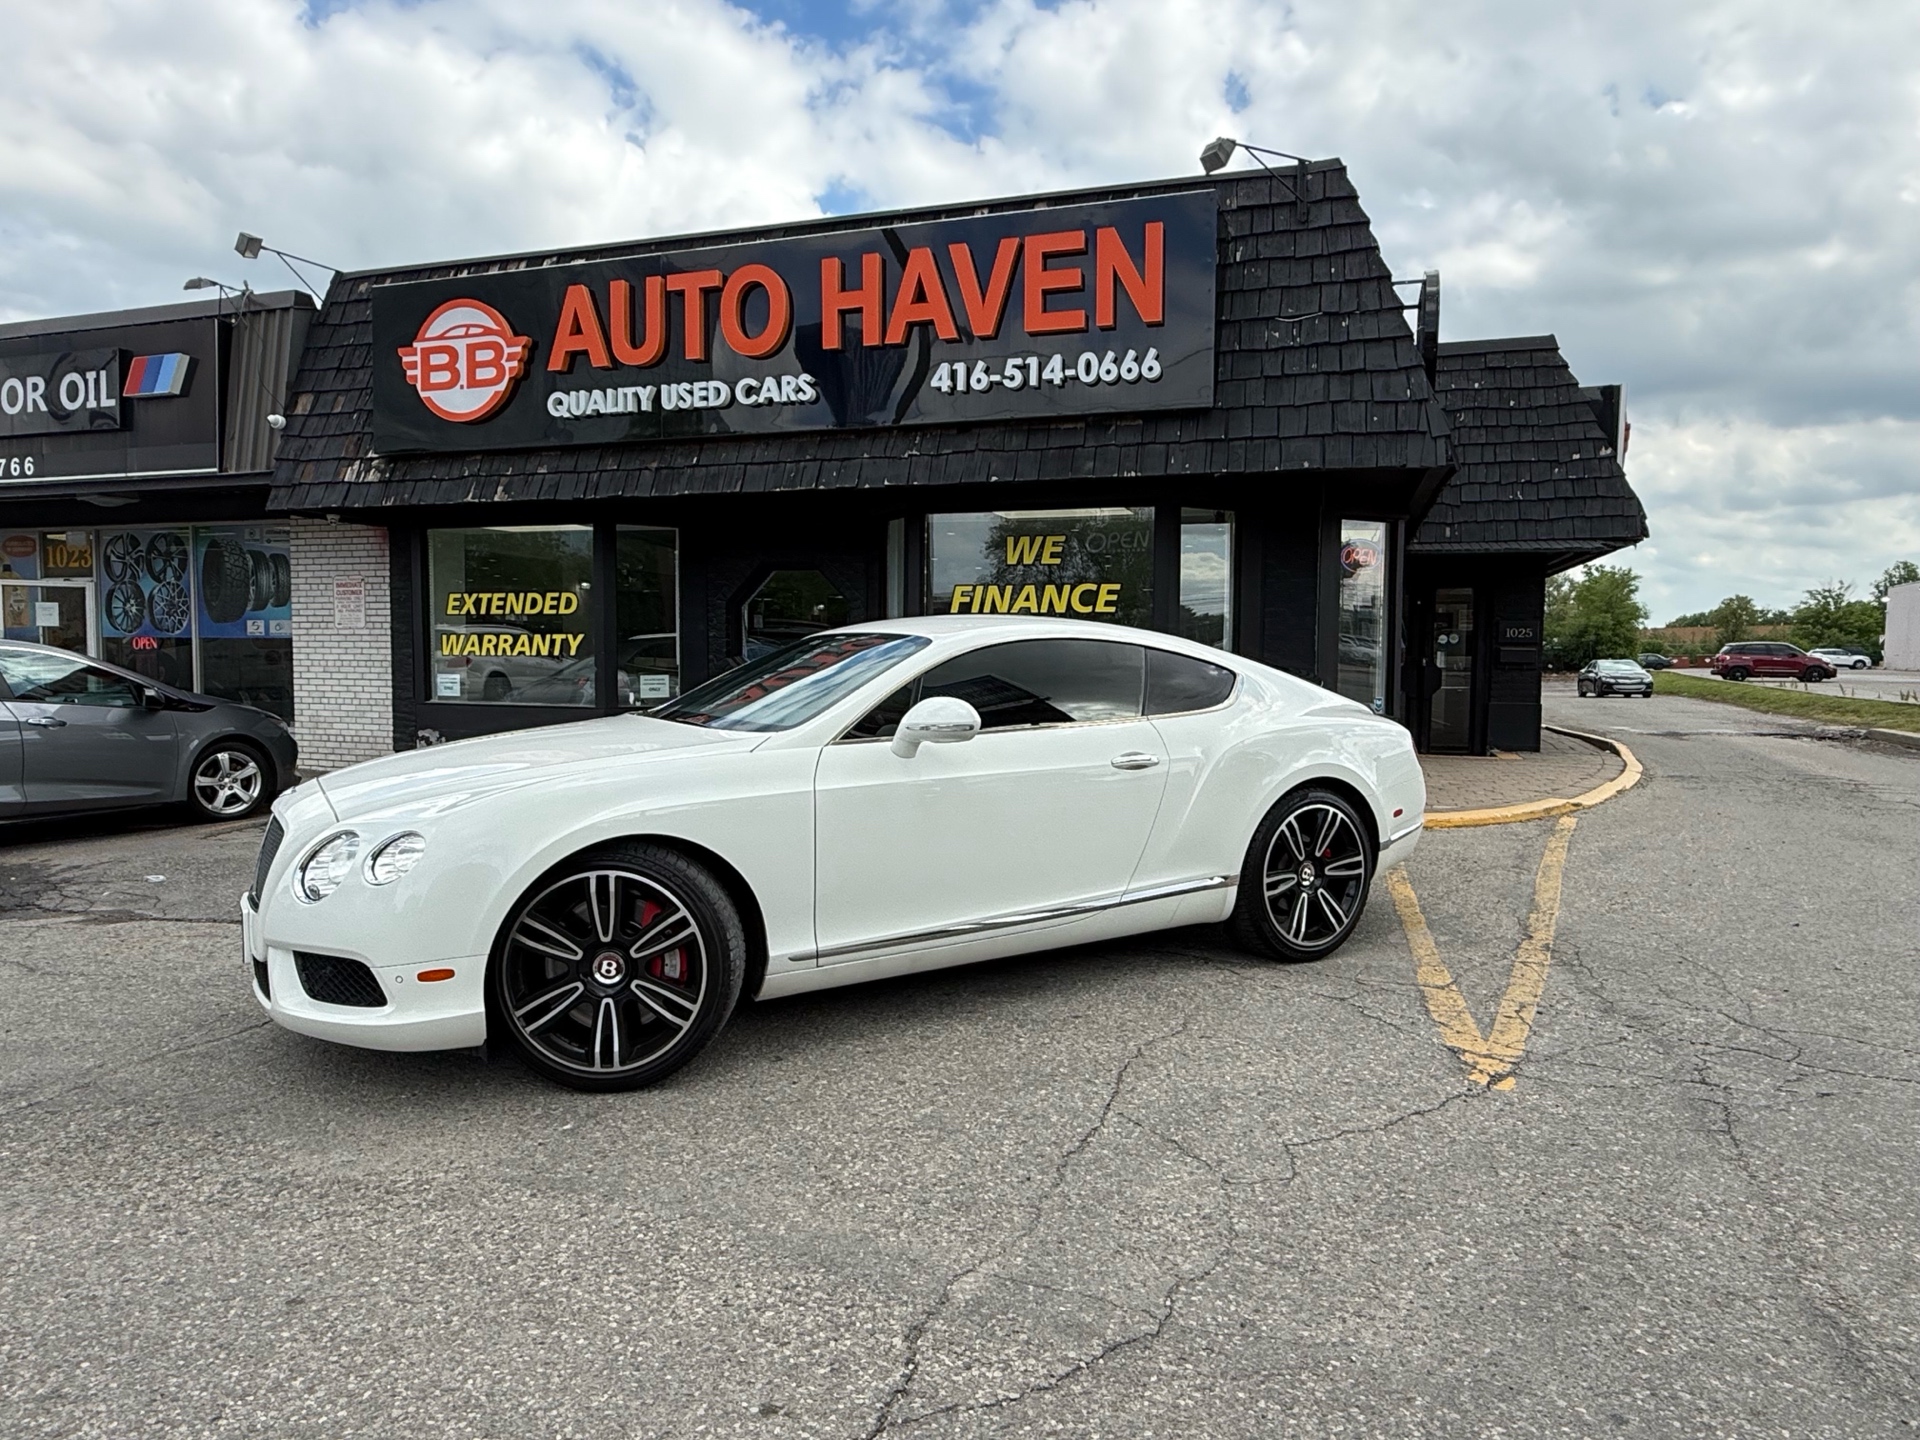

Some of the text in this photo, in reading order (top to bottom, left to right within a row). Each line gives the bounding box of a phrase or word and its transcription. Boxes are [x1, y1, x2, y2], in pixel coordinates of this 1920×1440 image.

[547, 221, 1165, 372] AUTO HAVEN
[931, 347, 1162, 394] 416-514-0666
[59, 370, 116, 411] OIL
[547, 373, 817, 419] QUALITY USED CARS
[1005, 534, 1066, 565] WE
[1085, 530, 1150, 553] OPEN
[46, 545, 92, 568] 1023
[1343, 547, 1378, 566] OPEN
[446, 592, 578, 616] EXTENDED
[950, 583, 1121, 614] FINANCE
[132, 636, 158, 650] OPEN
[1505, 627, 1533, 638] 1025
[441, 633, 584, 657] WARRANTY
[600, 960, 617, 977] B
